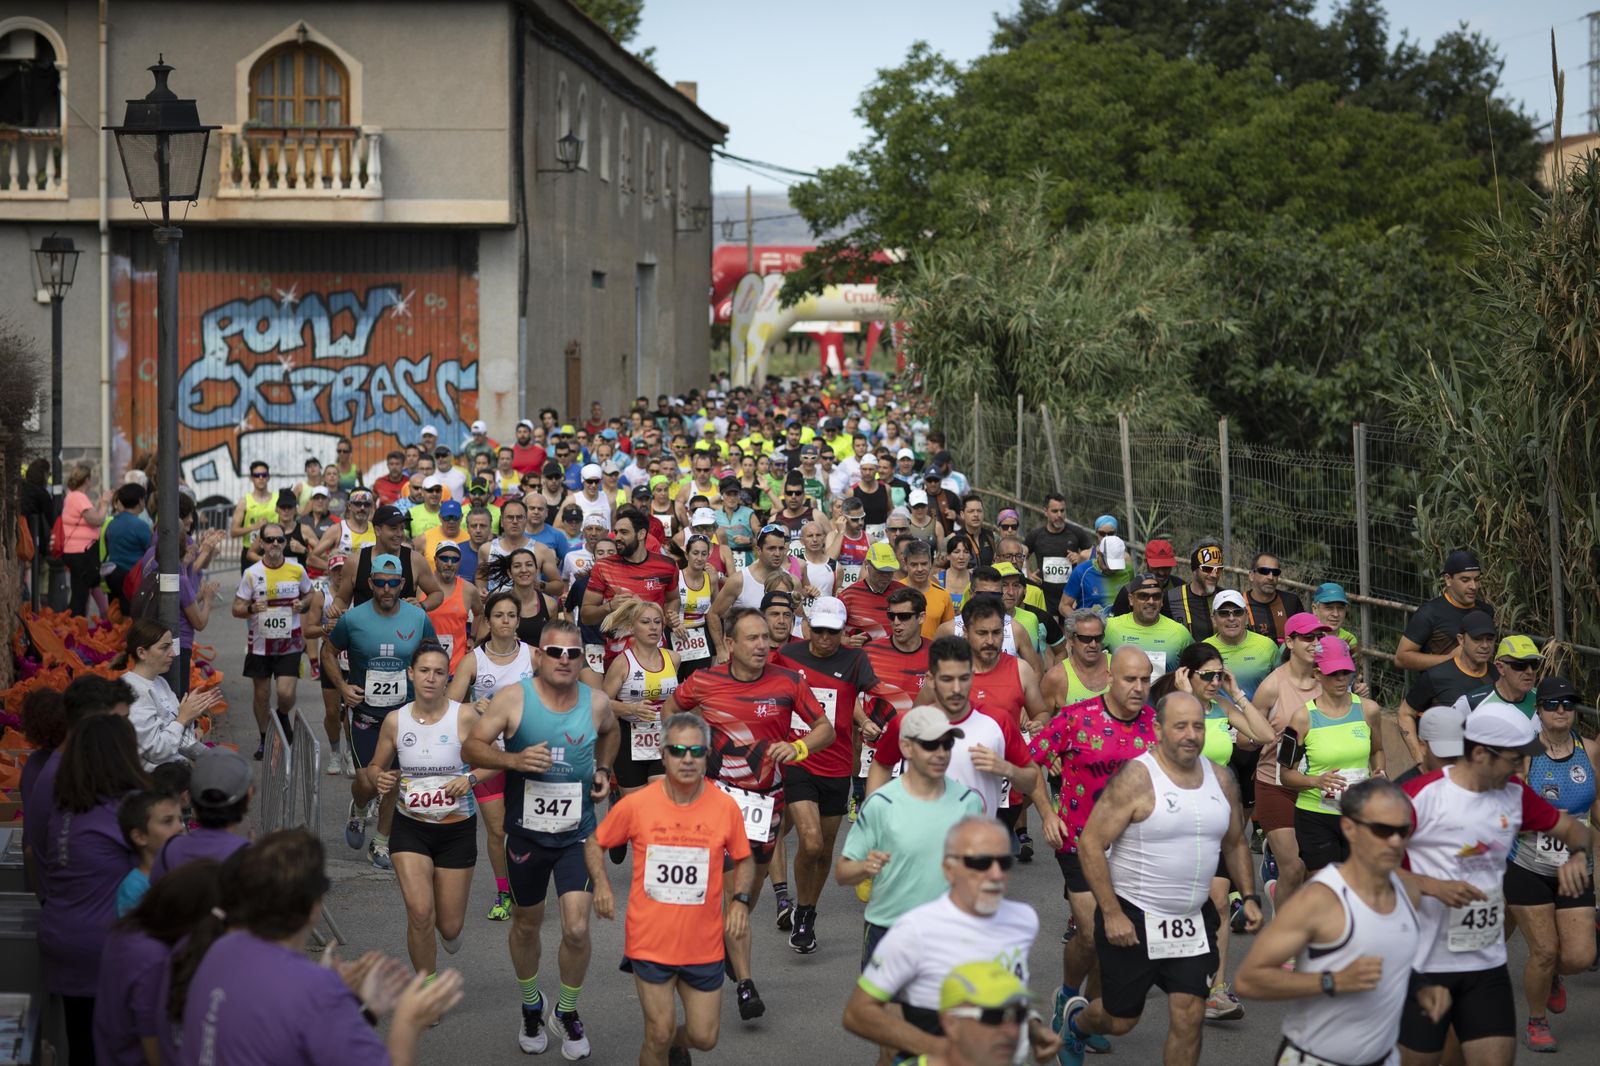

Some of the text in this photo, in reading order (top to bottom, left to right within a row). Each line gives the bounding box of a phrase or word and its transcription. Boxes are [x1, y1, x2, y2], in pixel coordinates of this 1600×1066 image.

[202, 284, 400, 360] PONY
[177, 353, 478, 449] EXPRESS
[1045, 566, 1070, 575] 3067
[264, 618, 286, 629] 405
[675, 637, 705, 652] 2088
[588, 654, 603, 664] 21
[373, 682, 399, 695] 221
[634, 732, 661, 748] 209
[1000, 779, 1010, 793] 2
[409, 790, 456, 808] 2045
[534, 798, 572, 817] 347
[741, 805, 763, 824] 10
[1541, 834, 1569, 852] 30
[657, 864, 698, 885] 308
[1461, 905, 1499, 930] 435
[1158, 918, 1197, 939] 183
